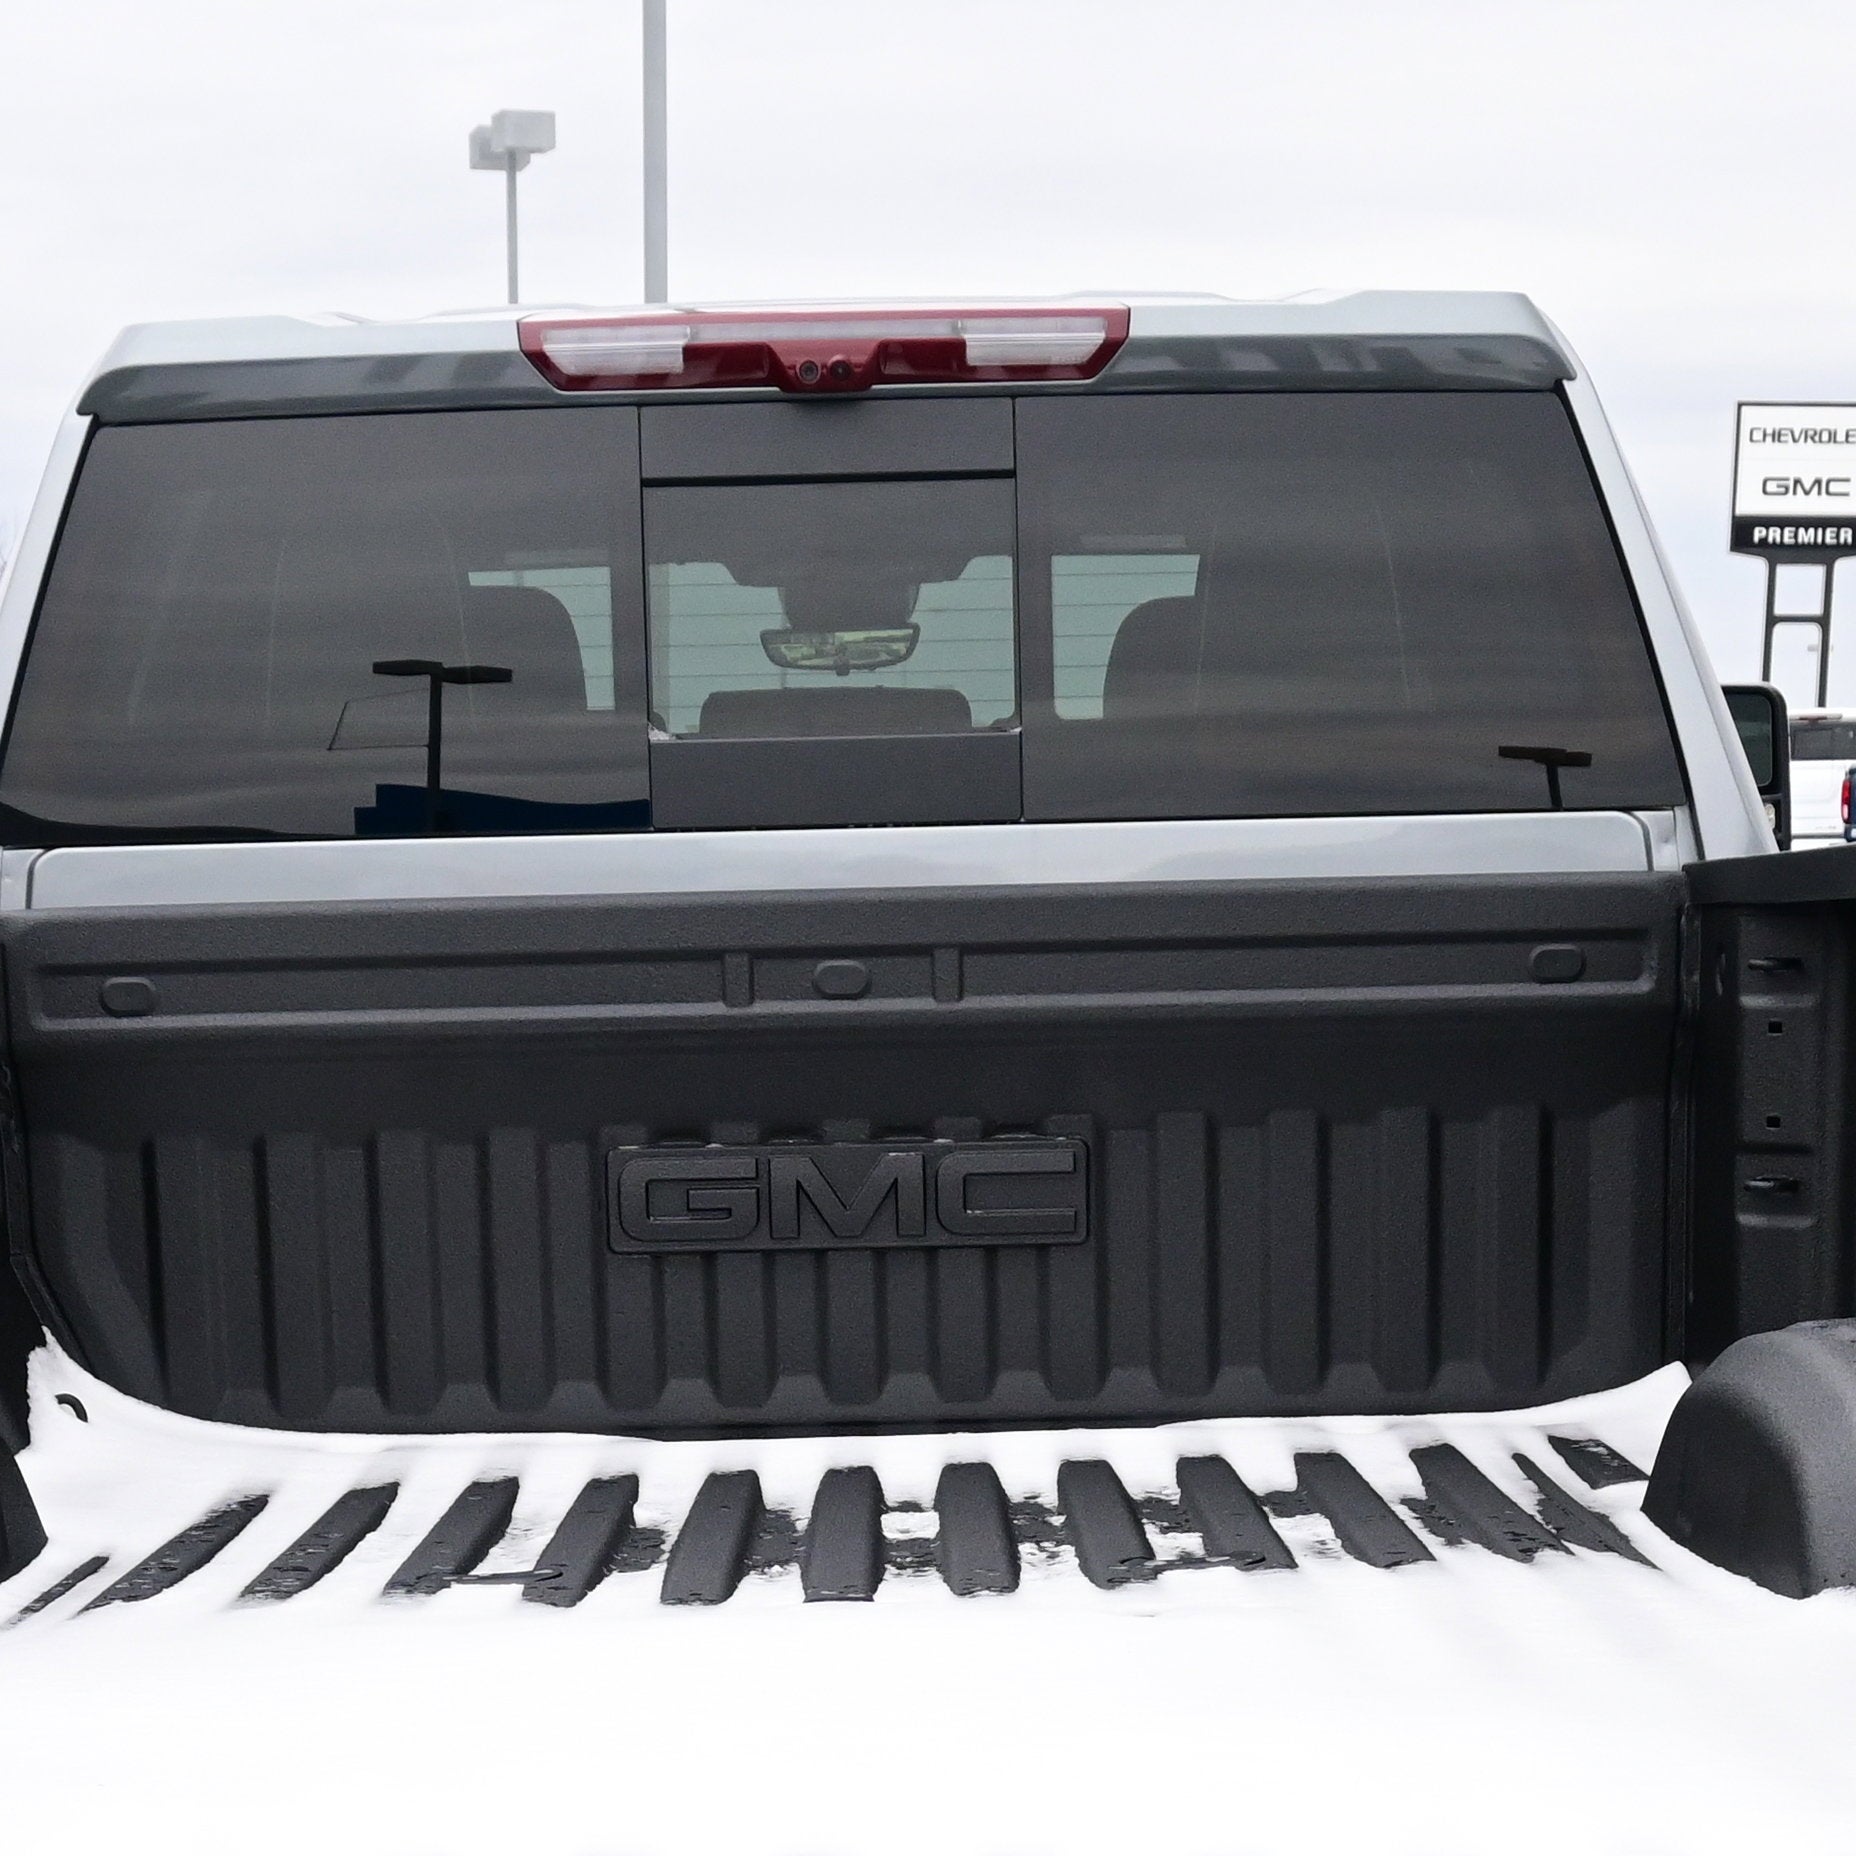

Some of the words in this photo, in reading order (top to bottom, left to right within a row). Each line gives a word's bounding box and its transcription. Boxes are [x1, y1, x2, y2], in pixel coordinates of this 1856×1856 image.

[1762, 477, 1851, 496] GMC
[1753, 527, 1853, 545] PREMIER
[618, 1150, 1078, 1243] GMC
